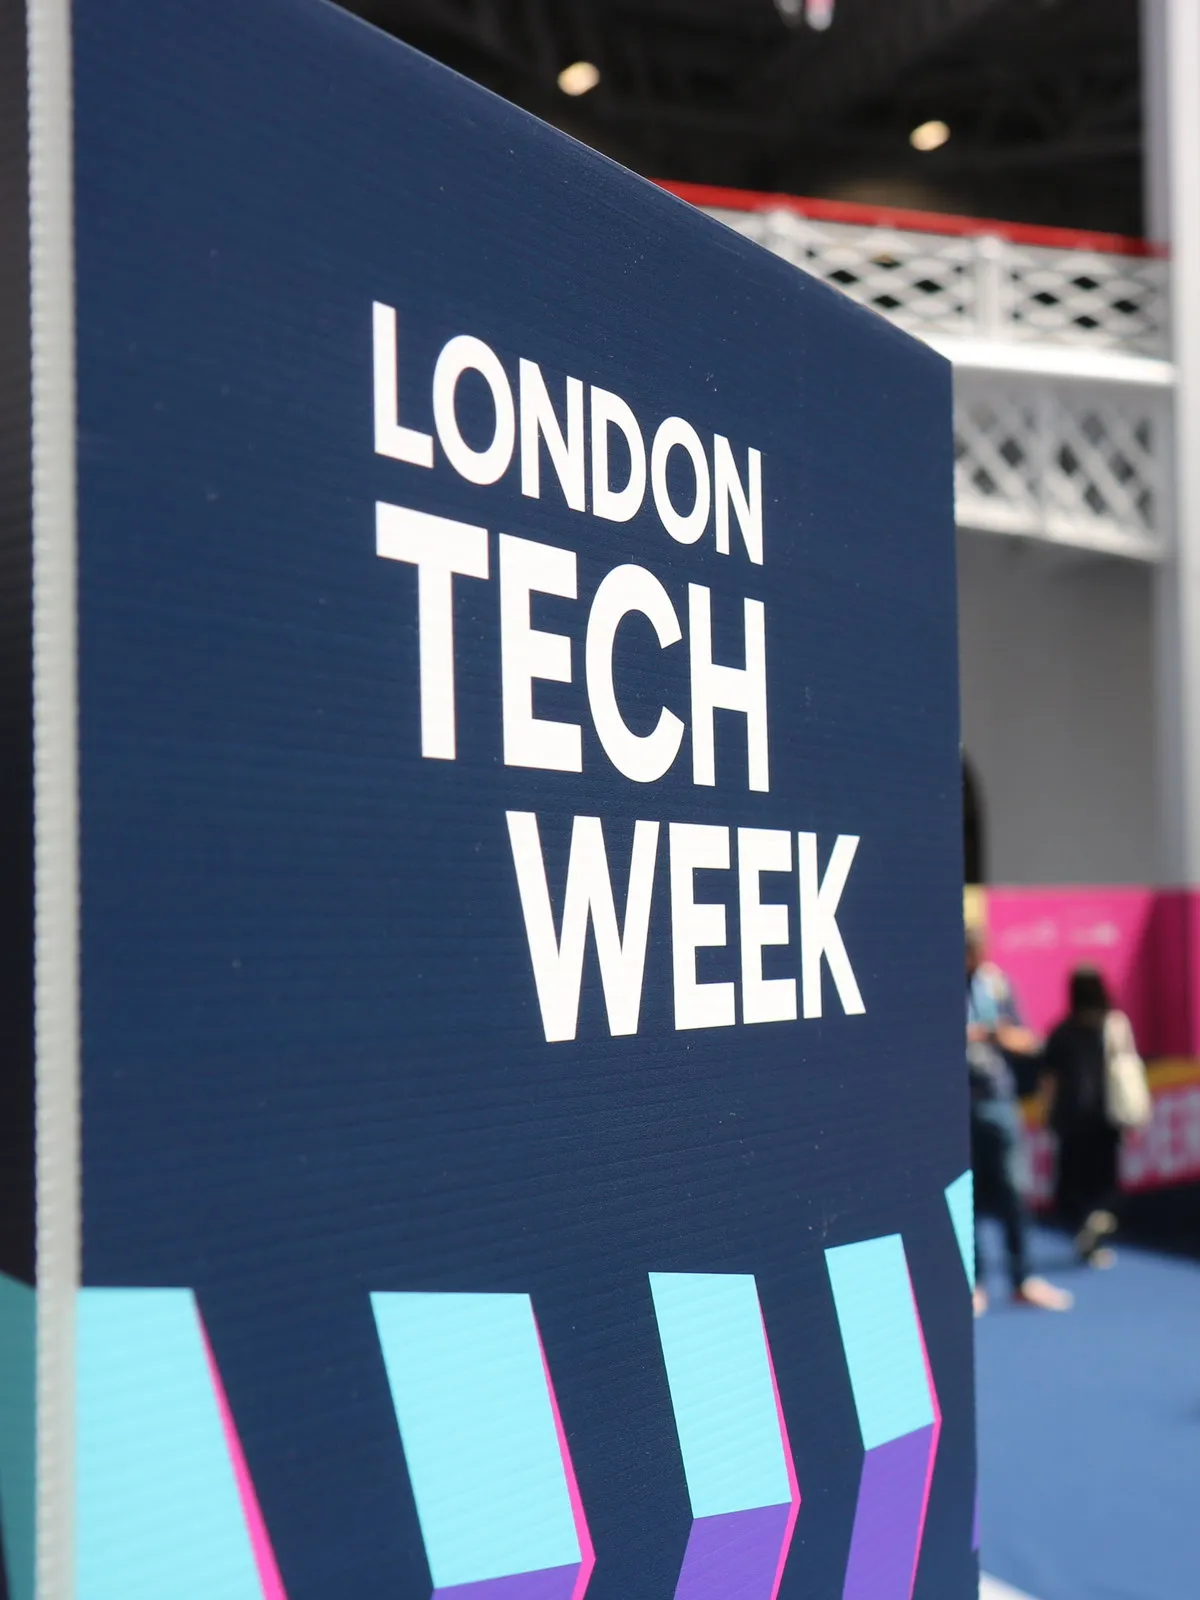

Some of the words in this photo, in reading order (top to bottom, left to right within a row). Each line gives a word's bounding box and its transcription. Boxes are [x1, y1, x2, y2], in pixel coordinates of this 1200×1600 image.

[372, 301, 764, 566] LONDON
[375, 501, 770, 793] TECH
[505, 810, 866, 1043] WEEK
